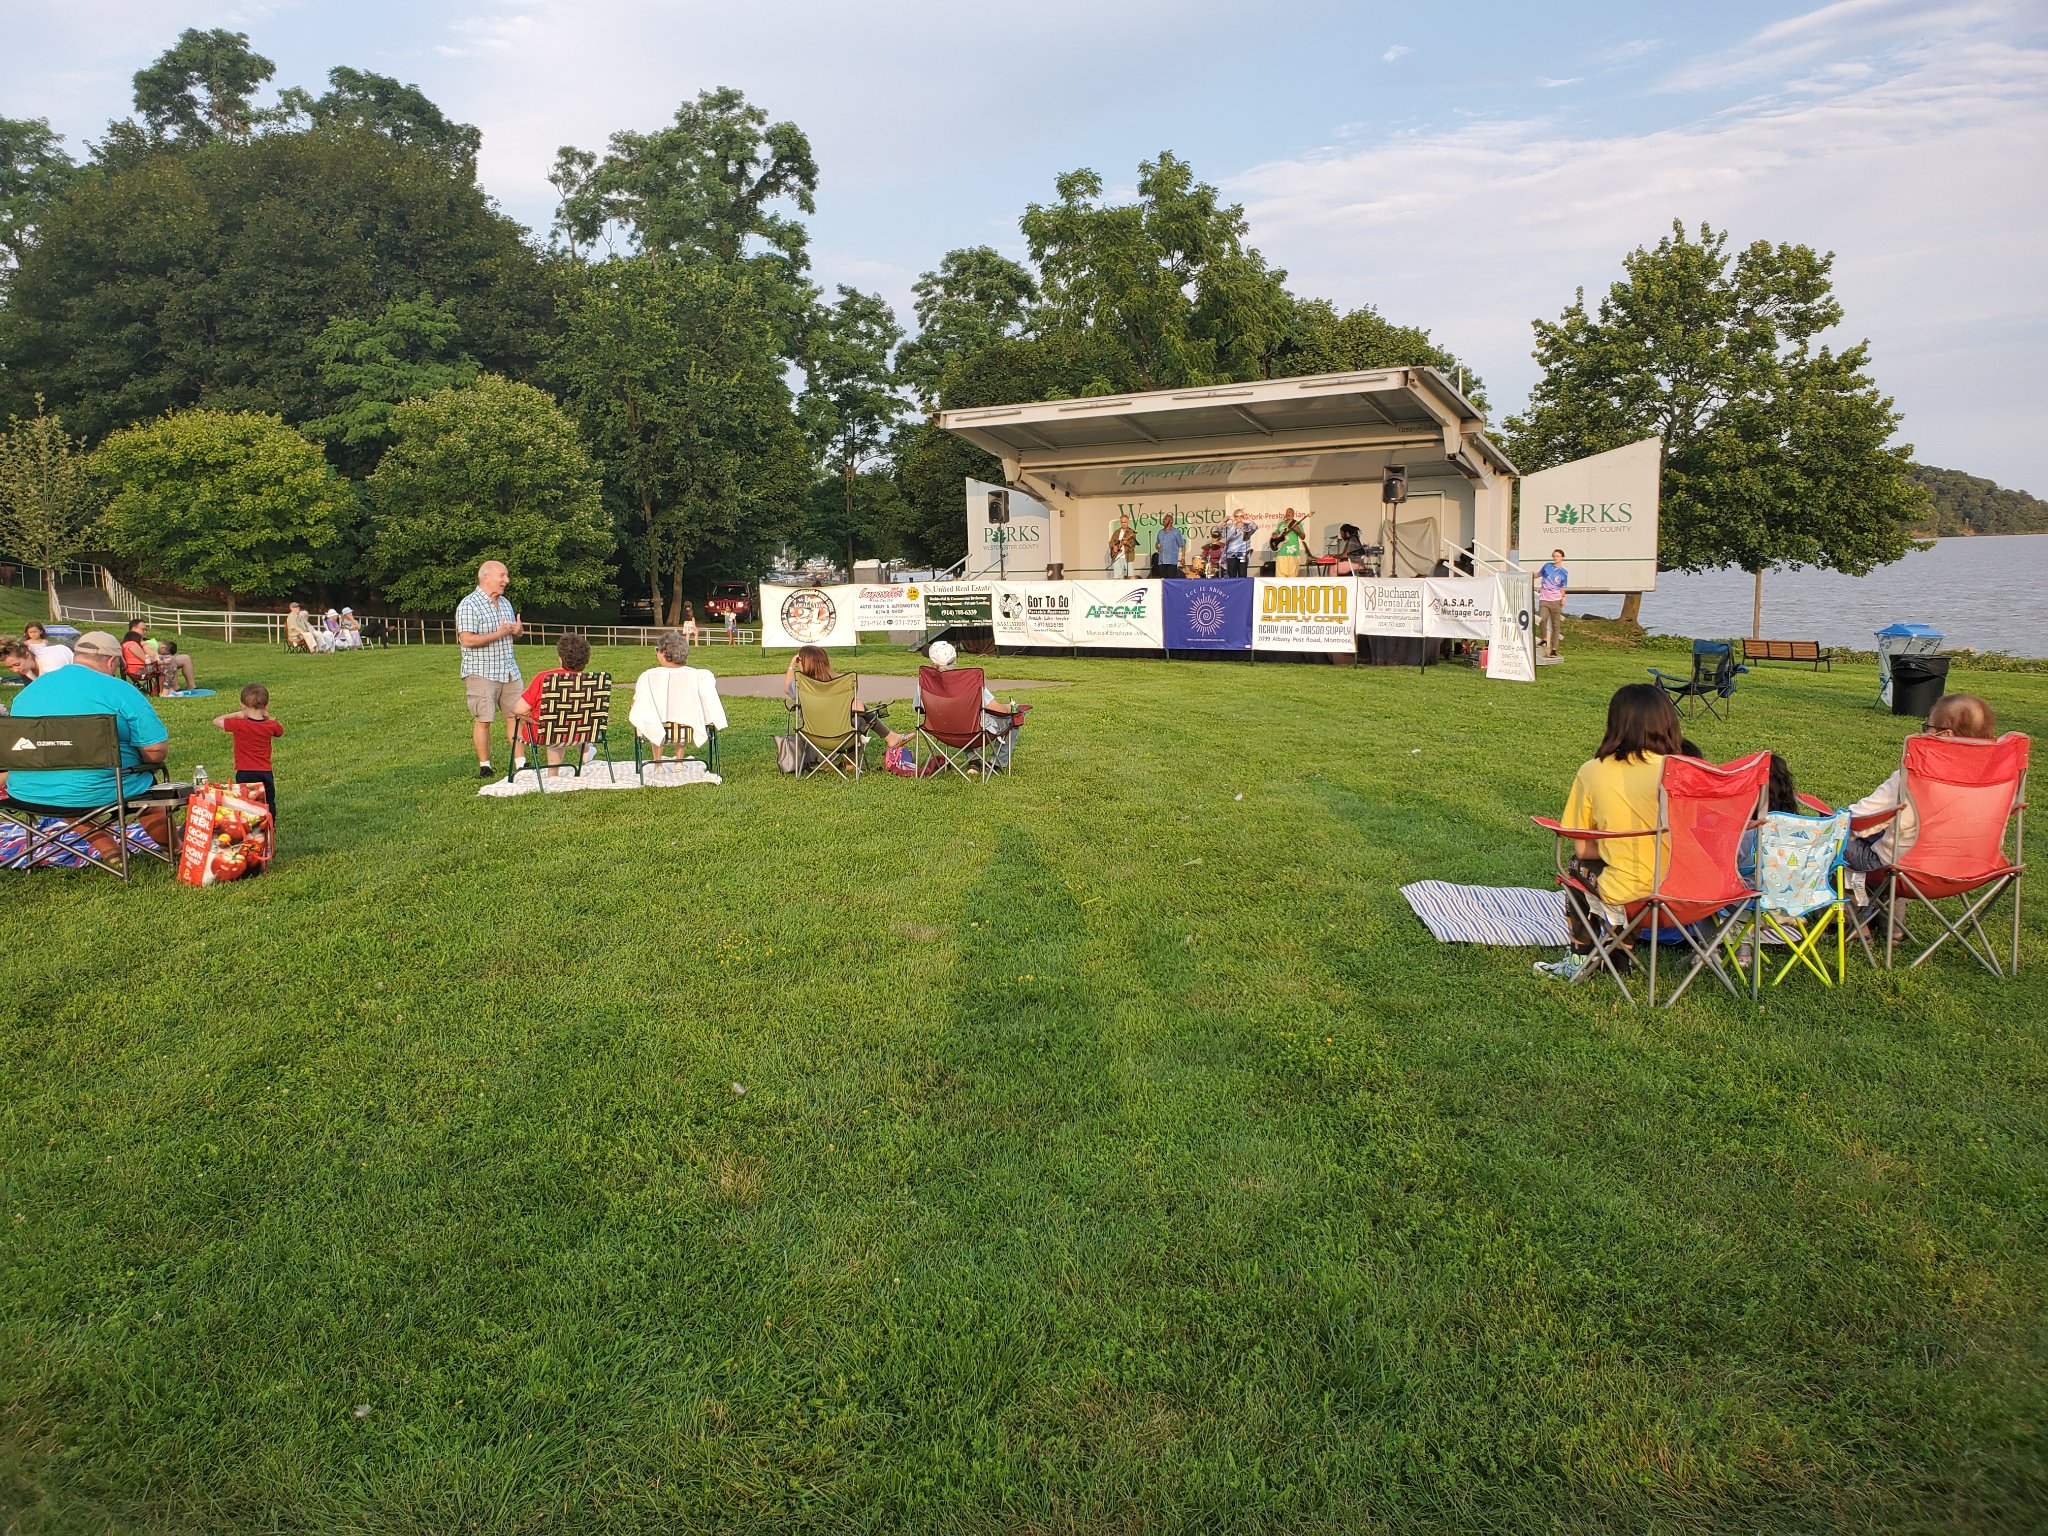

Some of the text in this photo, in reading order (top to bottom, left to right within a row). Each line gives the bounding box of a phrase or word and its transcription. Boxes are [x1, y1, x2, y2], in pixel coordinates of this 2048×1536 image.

[1542, 526, 1597, 534] WESTCHESTER
[971, 584, 991, 592] Estate
[1377, 586, 1421, 599] Buchanan
[1262, 585, 1348, 615] DAKOTA
[1377, 598, 1421, 608] Dental Arts
[1443, 598, 1474, 608] A.S.A.P.
[1085, 605, 1147, 619] AFSCME
[1441, 608, 1492, 618] Mortgage Corp.
[1313, 615, 1349, 624] CORP
[1518, 609, 1530, 631] 9
[1258, 625, 1279, 634] READY
[1280, 625, 1293, 634] MIX
[1300, 625, 1325, 635] MASON
[1325, 626, 1351, 635] SUPPLY
